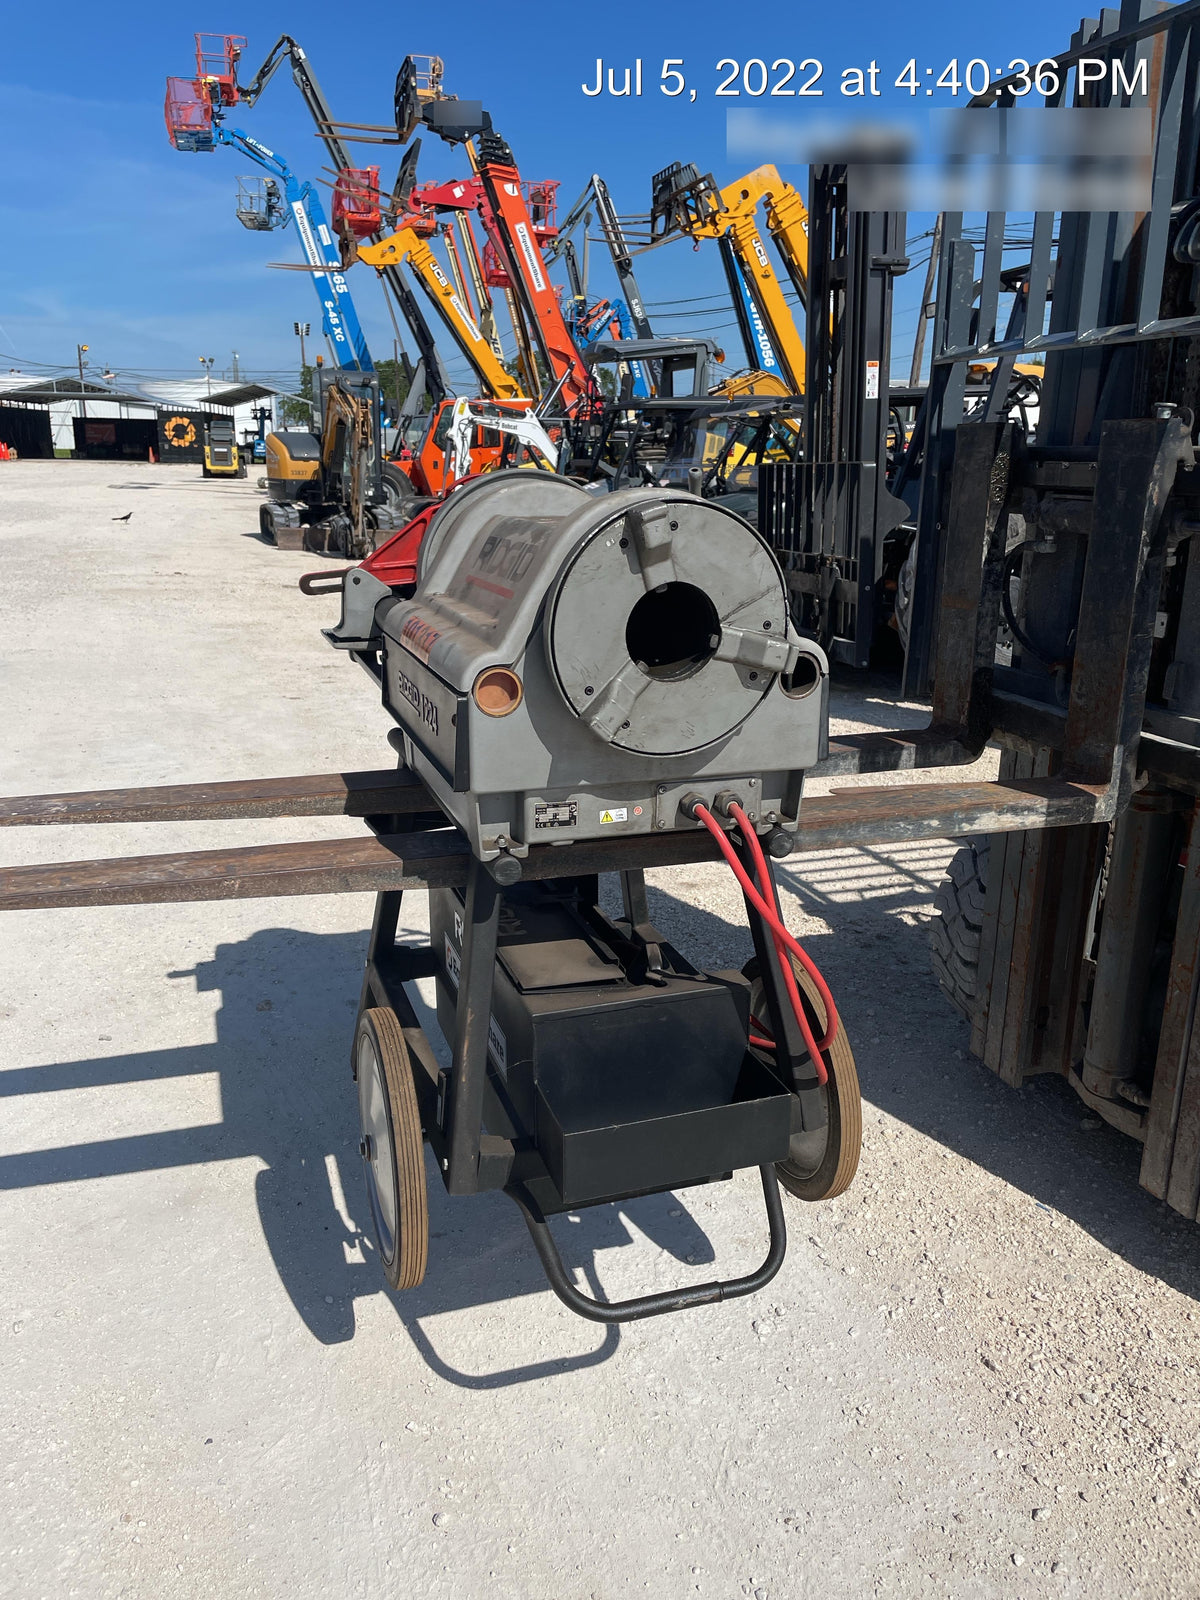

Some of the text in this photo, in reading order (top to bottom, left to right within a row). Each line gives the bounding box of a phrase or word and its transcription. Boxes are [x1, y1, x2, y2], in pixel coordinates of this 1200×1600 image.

[521, 234, 542, 288] EquipmentShare
[751, 238, 769, 267] JCB
[429, 262, 449, 288] JCB
[333, 327, 345, 342] XC
[501, 422, 518, 431] Bobcat
